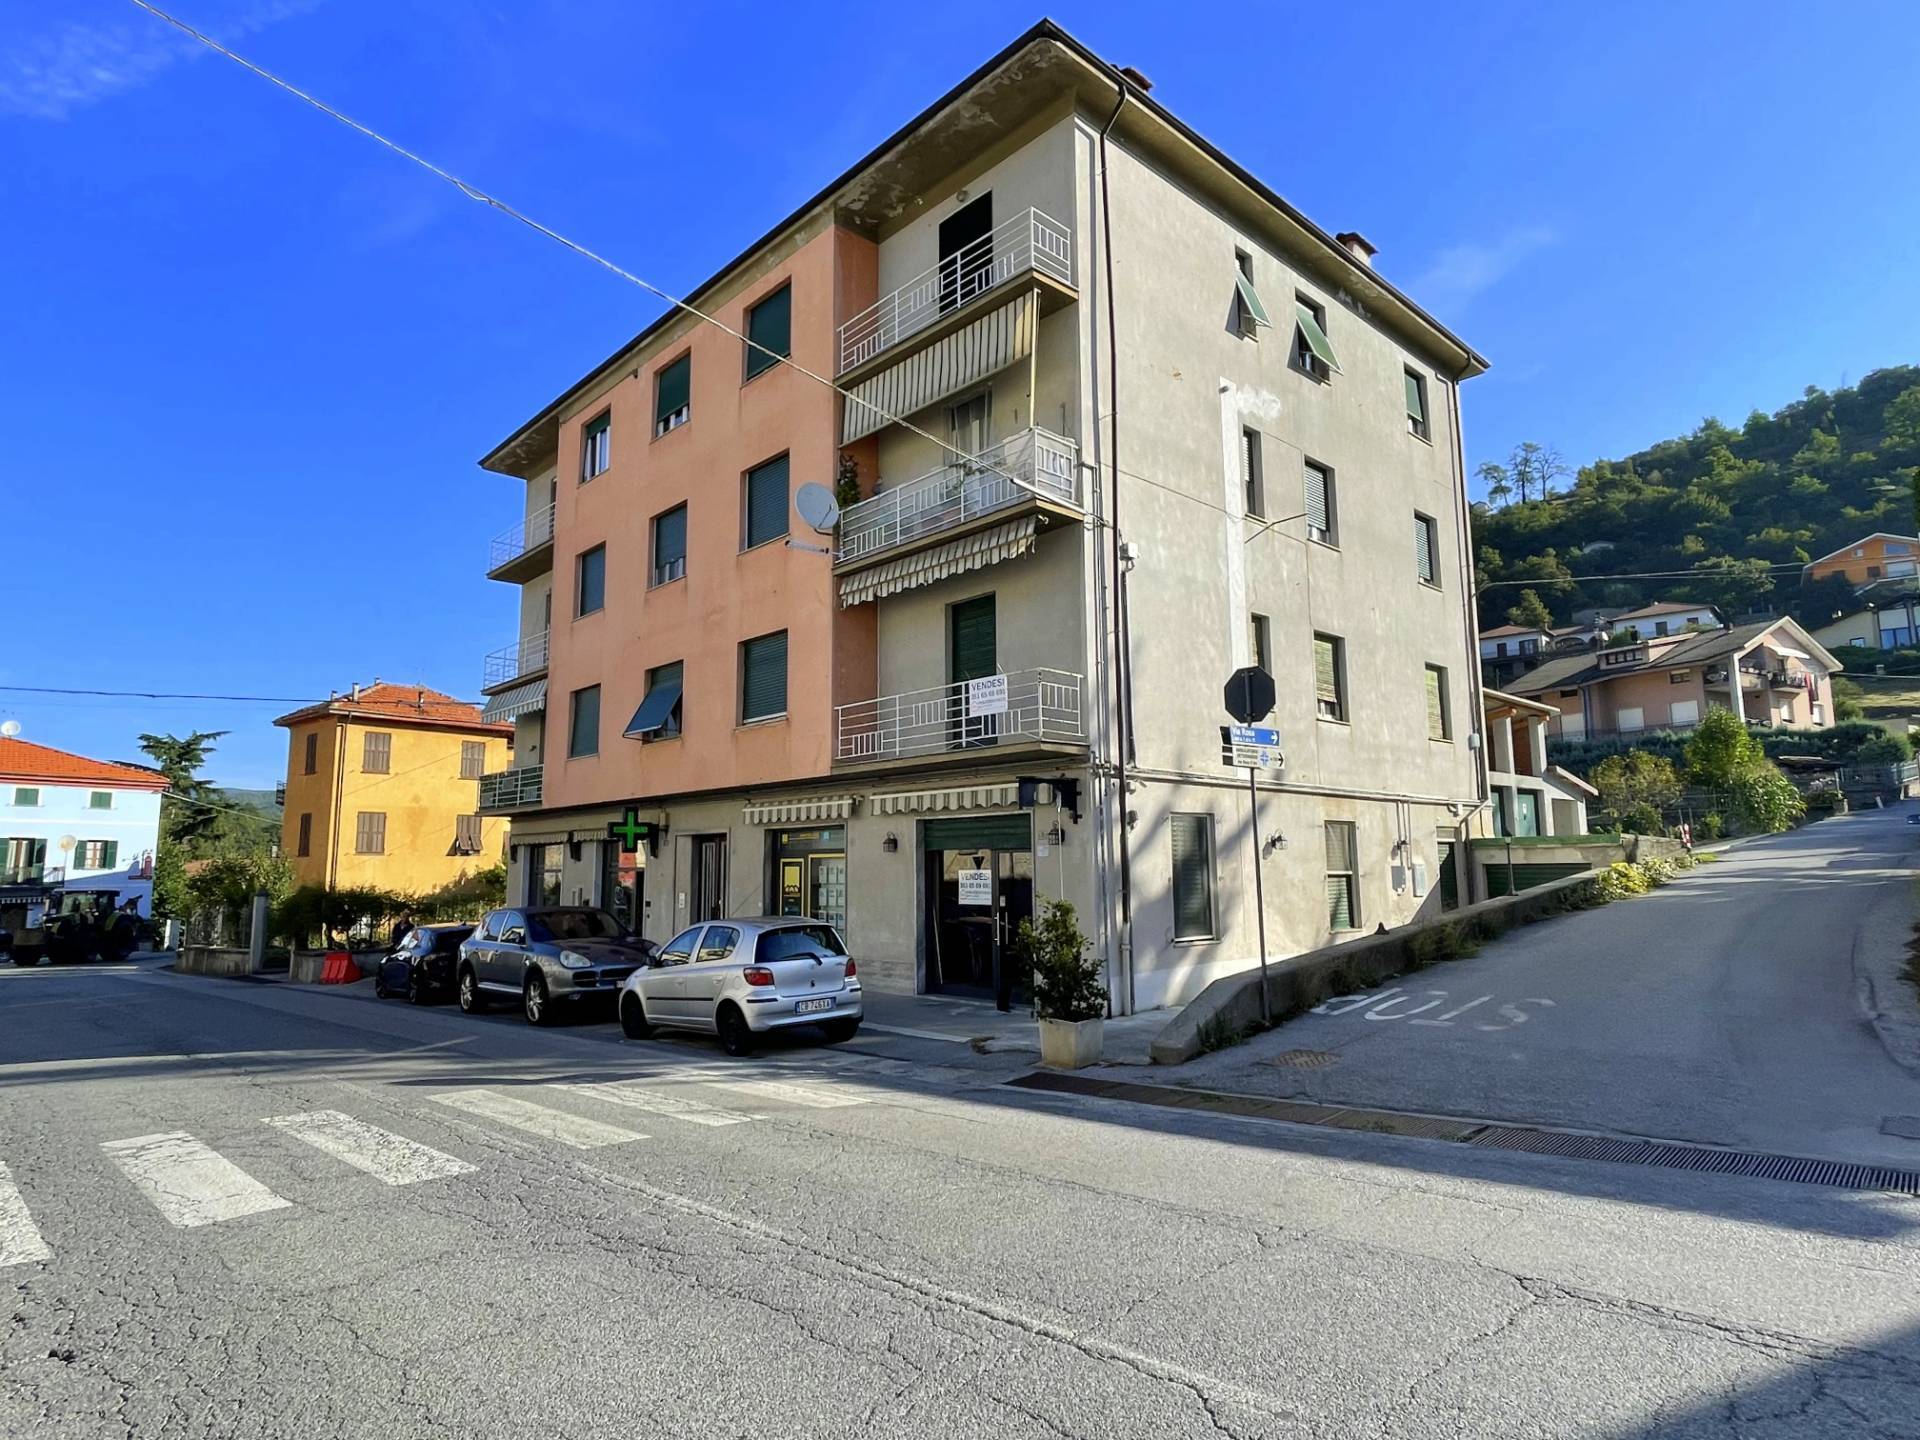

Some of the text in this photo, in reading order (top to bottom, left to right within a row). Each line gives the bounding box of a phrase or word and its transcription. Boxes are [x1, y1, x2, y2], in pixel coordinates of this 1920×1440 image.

[971, 678, 1005, 691] VENDESI
[1232, 727, 1241, 736] Via
[1310, 987, 1557, 1031] STOP
